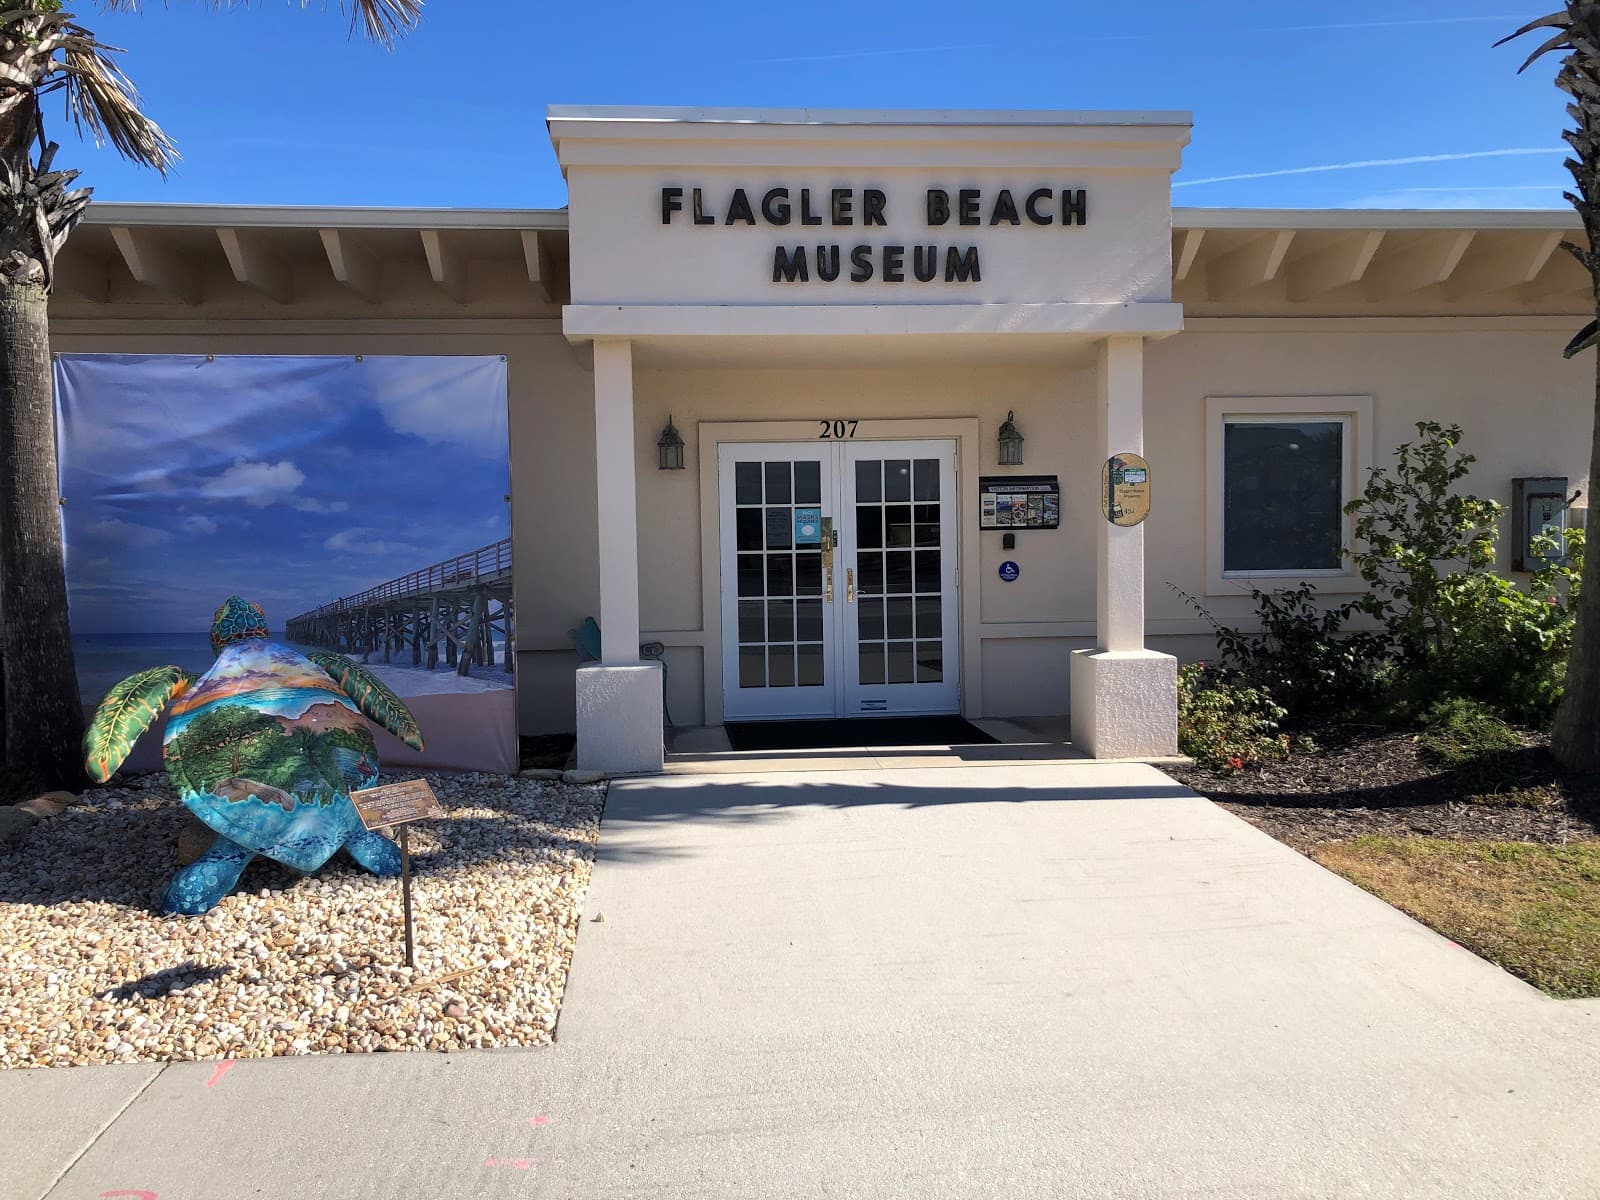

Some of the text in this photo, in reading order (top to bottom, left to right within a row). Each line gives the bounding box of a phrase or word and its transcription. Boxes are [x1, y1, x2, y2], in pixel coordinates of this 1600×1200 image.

[661, 187, 1087, 226] FLAGLER BEACH
[772, 245, 982, 283] MUSEUM
[819, 419, 859, 439] 207
